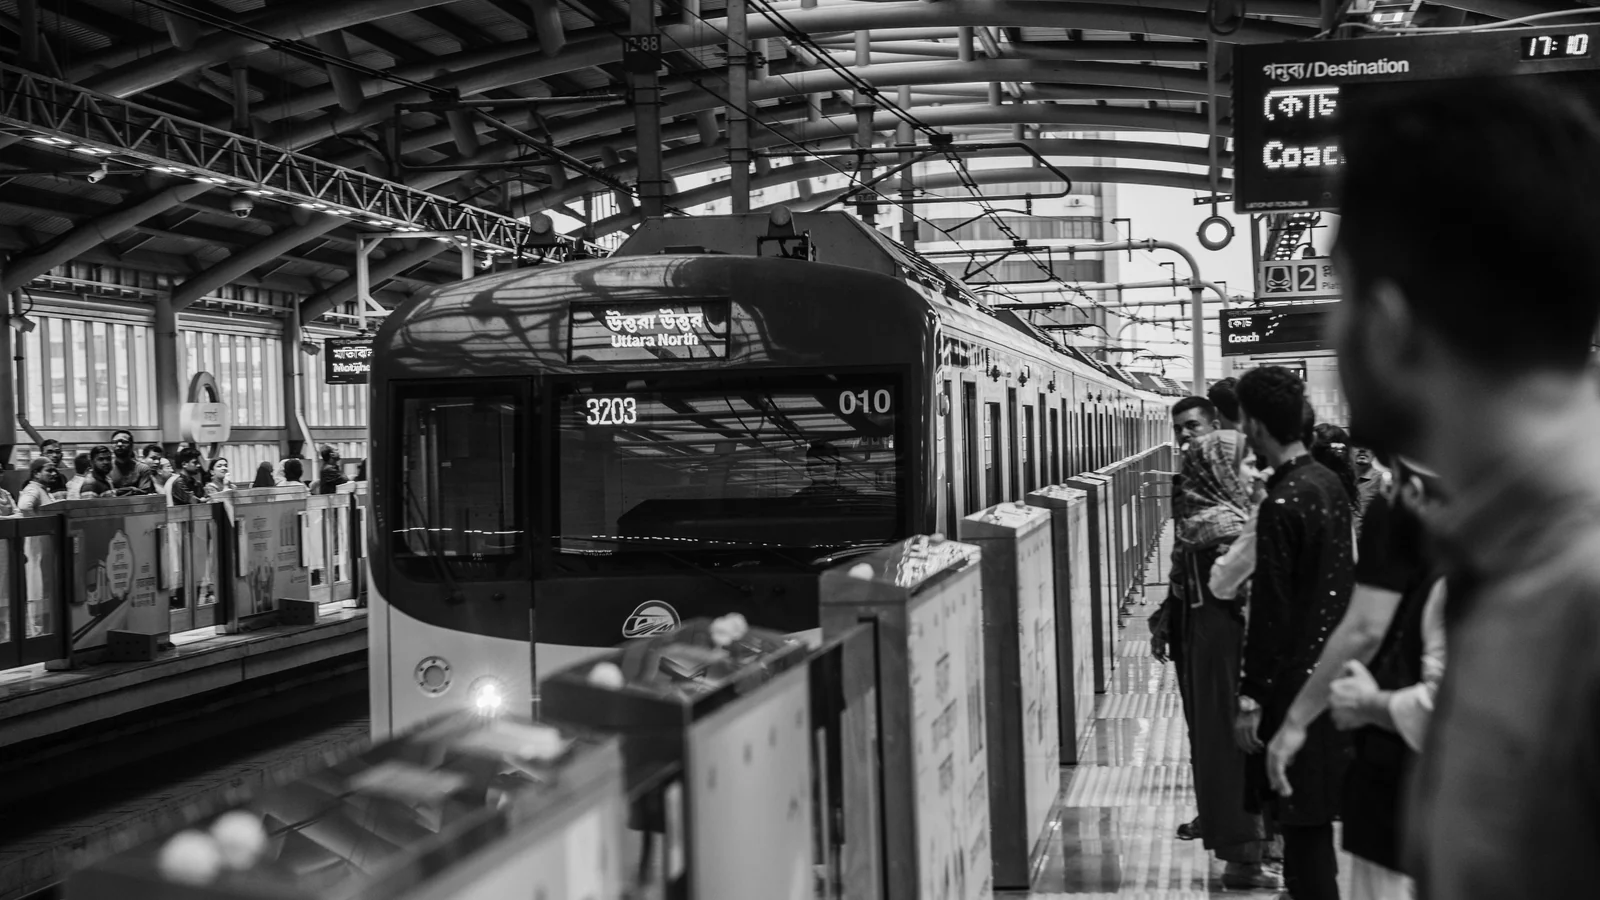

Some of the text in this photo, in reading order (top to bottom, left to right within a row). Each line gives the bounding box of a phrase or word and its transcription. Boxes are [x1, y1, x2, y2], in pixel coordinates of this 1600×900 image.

[1529, 34, 1589, 57] 17:10
[1263, 141, 1346, 168] Coac
[1299, 267, 1316, 290] 2
[605, 308, 704, 333] উত্তরা উত্তর
[611, 332, 699, 348] Uttara North
[1228, 331, 1260, 343] Coach
[586, 397, 637, 425] 3203
[838, 388, 891, 415] 010
